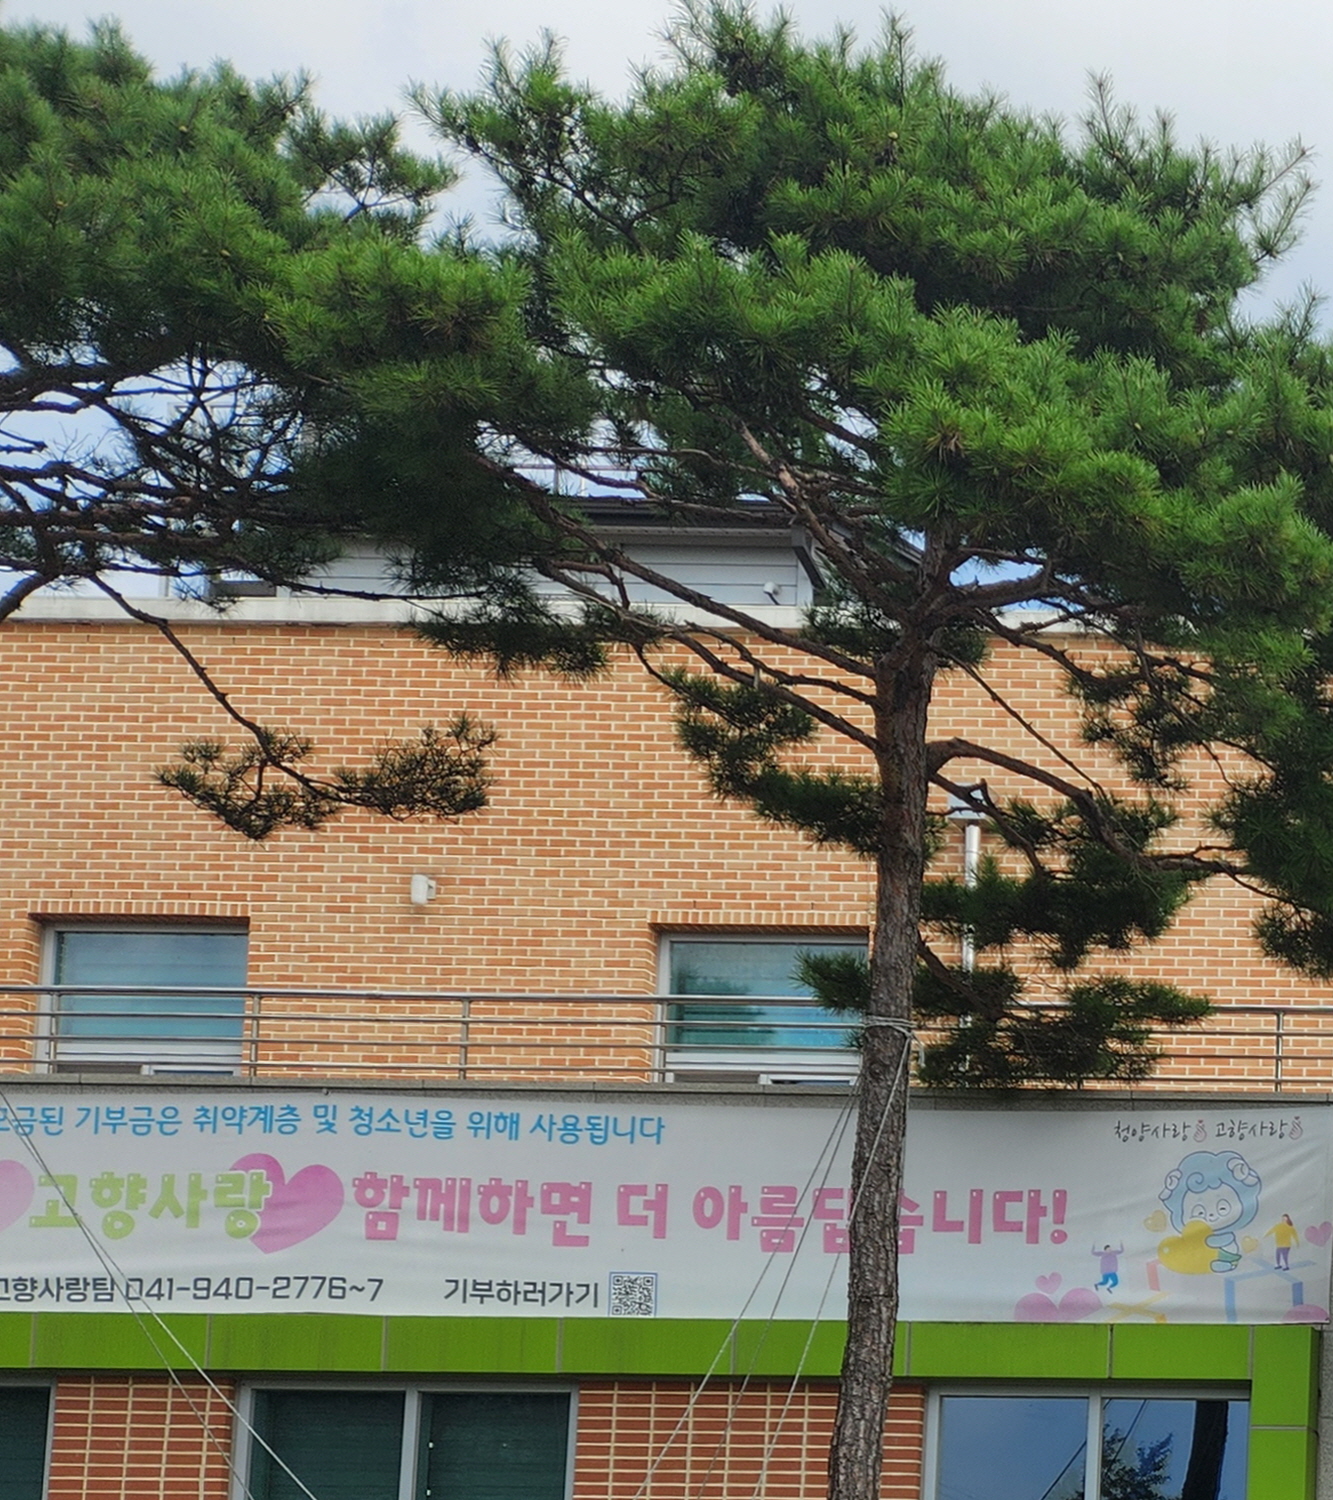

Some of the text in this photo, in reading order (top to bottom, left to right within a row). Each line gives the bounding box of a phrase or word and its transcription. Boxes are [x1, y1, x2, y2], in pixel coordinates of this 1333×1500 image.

[75, 1106, 183, 1136] 기부금은
[193, 1104, 302, 1135] 취약계층
[312, 1105, 338, 1135] 및
[348, 1106, 457, 1140] 청소년을
[466, 1111, 520, 1141] 위해
[530, 1113, 666, 1145] 사용됩니다
[1114, 1119, 1288, 1143] 청양사랑 고향사랑
[27, 1171, 273, 1241] 고향사랑
[352, 1170, 593, 1248] 함께하면
[616, 1183, 669, 1240] 더
[125, 1275, 384, 1302] 041-940-2776~7
[443, 1278, 600, 1308] 기부하러가기
